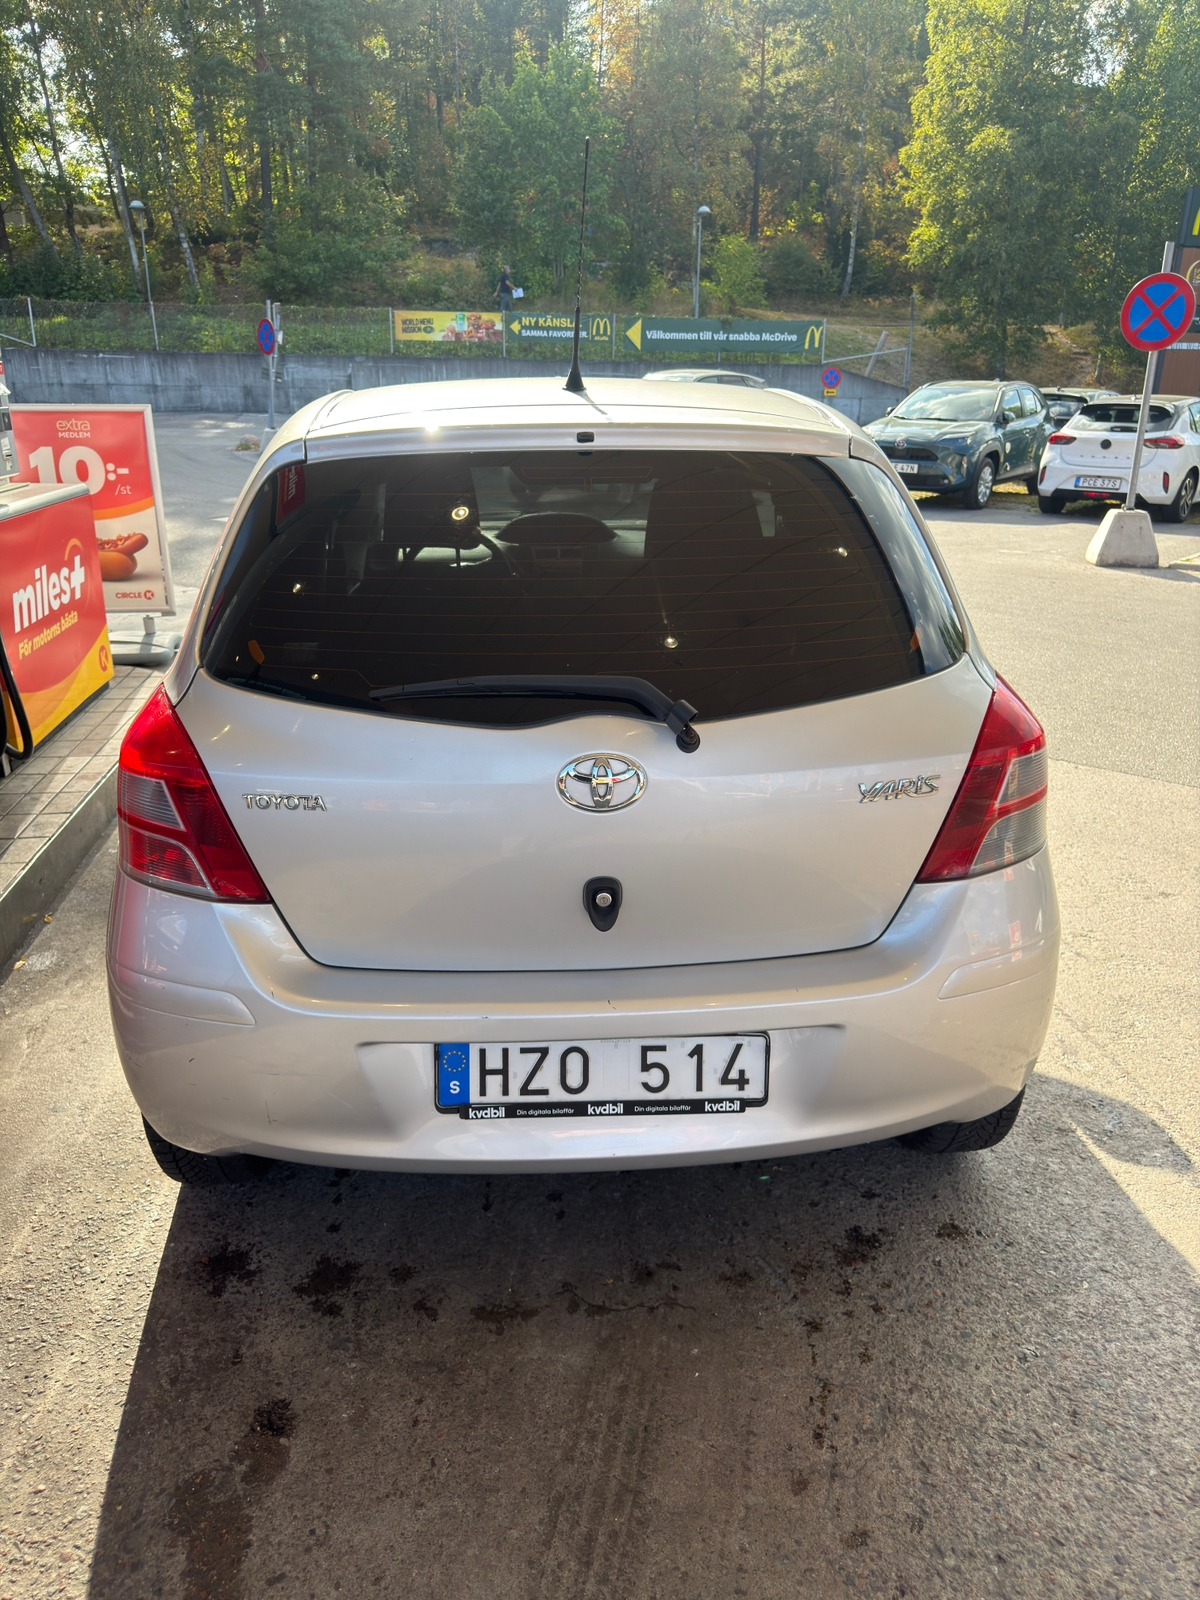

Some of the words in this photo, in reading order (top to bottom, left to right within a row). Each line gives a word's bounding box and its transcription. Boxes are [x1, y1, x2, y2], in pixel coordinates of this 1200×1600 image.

[521, 316, 536, 327] NY
[538, 315, 582, 328] KÄNSL.
[521, 329, 548, 338] SAMMA
[549, 330, 589, 338] FAVORIER.
[646, 330, 698, 340] Välkommen
[699, 331, 712, 340] till
[713, 331, 727, 341] vår
[728, 332, 760, 341] snabba
[761, 332, 797, 342] McDrive
[56, 418, 91, 431] extra
[1081, 478, 1098, 487] PCE
[115, 484, 132, 495] /st
[145, 591, 154, 600] K
[18, 639, 33, 660] För
[33, 625, 60, 651] motorns
[61, 610, 78, 631] bästa
[242, 794, 327, 811] TOYOTA
[478, 1046, 590, 1097] HZO
[640, 1043, 750, 1093] 514
[449, 1080, 460, 1094] S
[468, 1107, 506, 1119] kvdbil
[528, 1109, 551, 1117] digitala
[587, 1103, 624, 1115] kvdbil
[645, 1105, 668, 1113] digitala
[704, 1100, 741, 1112] kvdbil
